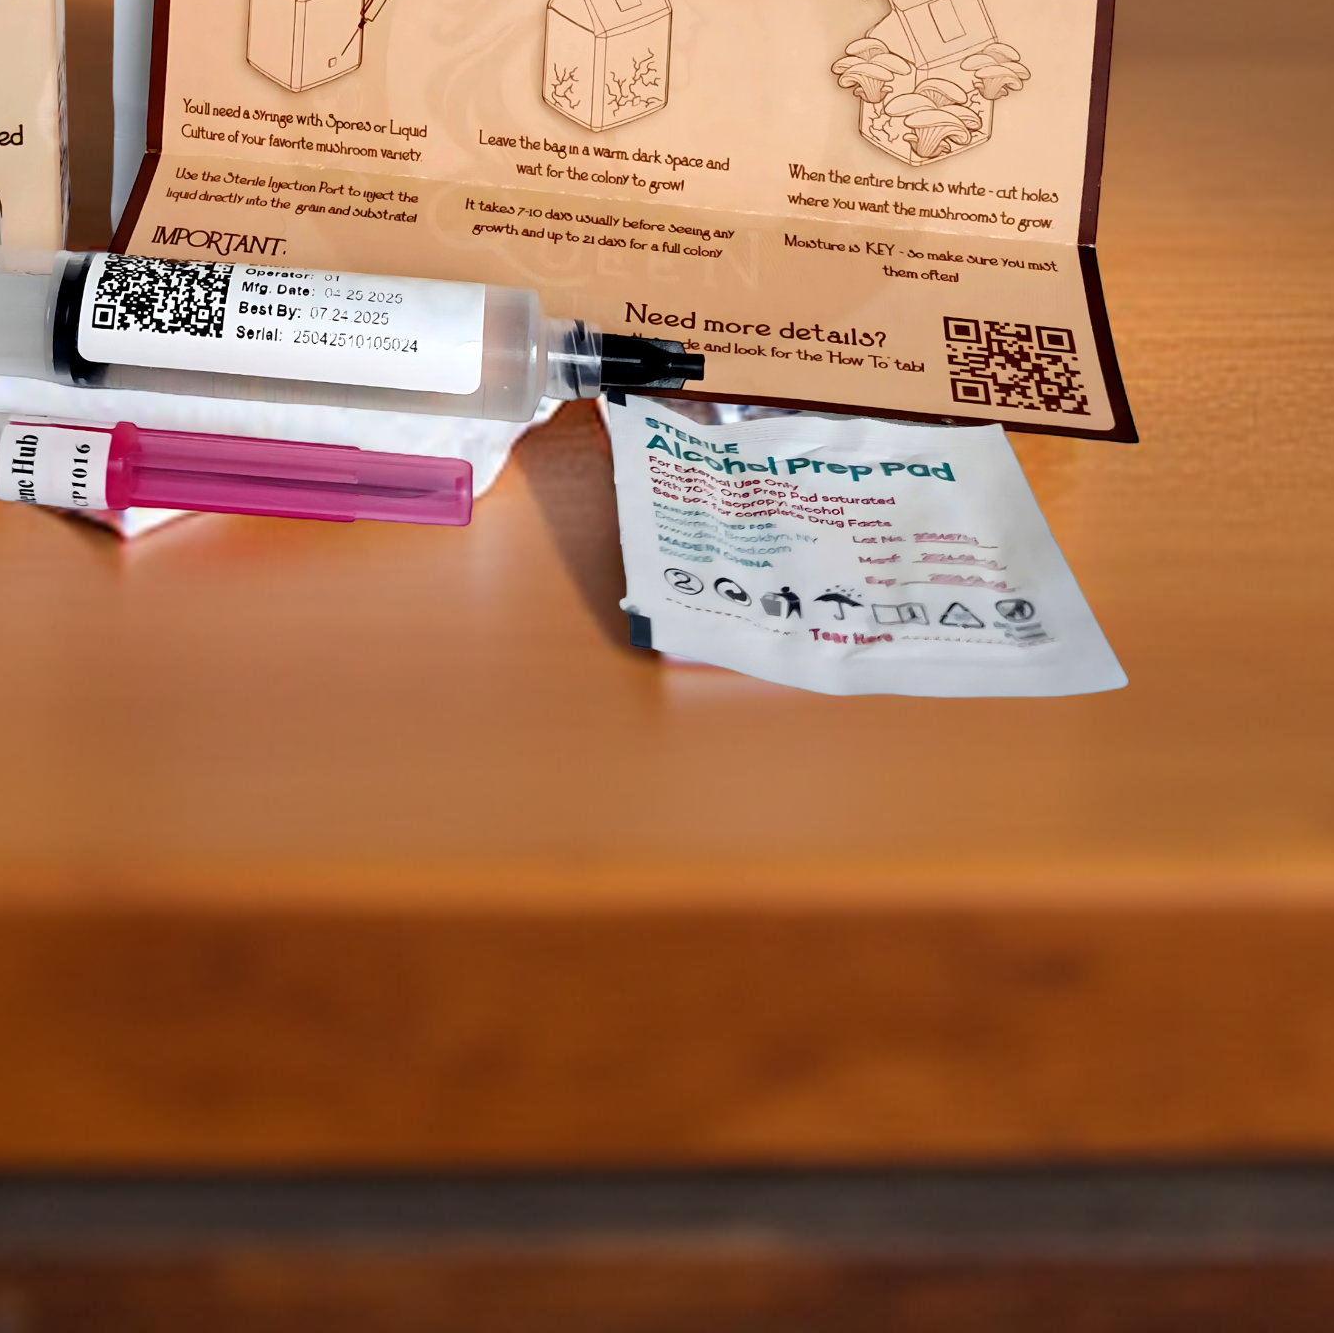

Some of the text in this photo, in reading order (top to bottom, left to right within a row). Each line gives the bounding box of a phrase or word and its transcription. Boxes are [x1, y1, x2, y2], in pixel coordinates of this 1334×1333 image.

[181, 123, 225, 142] Culture
[241, 133, 267, 146] your
[268, 133, 314, 151] favorite
[315, 140, 378, 158] mushroom
[212, 105, 241, 119] need
[252, 109, 294, 129] syringe
[296, 112, 324, 127] with
[325, 113, 372, 135] Spores
[389, 119, 428, 142] Liquid
[479, 129, 517, 148] Leave
[518, 135, 541, 151] the
[543, 138, 568, 160] bag
[631, 147, 662, 164] dark
[664, 153, 704, 172] space
[705, 157, 730, 171] and
[175, 167, 419, 204] Use the Sterile Injection Port inject the
[516, 162, 685, 195] wait for the colony grow!
[788, 163, 1059, 204] When the entire brick white cut holes
[166, 187, 418, 223] liquid directly into the grain and substrate!
[477, 200, 735, 242] takes 7-10 days usually before seeing any
[787, 192, 830, 208] where
[832, 197, 856, 211] you
[857, 200, 890, 214] want
[892, 201, 916, 216] the
[918, 206, 998, 224] mushrooms
[471, 223, 723, 258] growth and days for colony
[784, 233, 1059, 272] Moisture KEY make sure you mist
[242, 282, 272, 295] Mfg.
[277, 284, 315, 297] Date:
[245, 268, 314, 280] Operator:
[882, 264, 959, 283] them often!
[238, 300, 273, 316] Best
[276, 303, 301, 321] By:
[624, 301, 887, 348] Need more details?
[236, 325, 283, 342] Serial:
[703, 342, 731, 354] and
[734, 342, 768, 357] look
[770, 346, 793, 359] for
[795, 348, 823, 362] the
[645, 417, 740, 455] STERILE
[11, 435, 39, 476] Hub
[646, 435, 956, 482] Alcohol Prep Pad
[790, 492, 896, 505] Pad saturated
[808, 515, 844, 528] Drug
